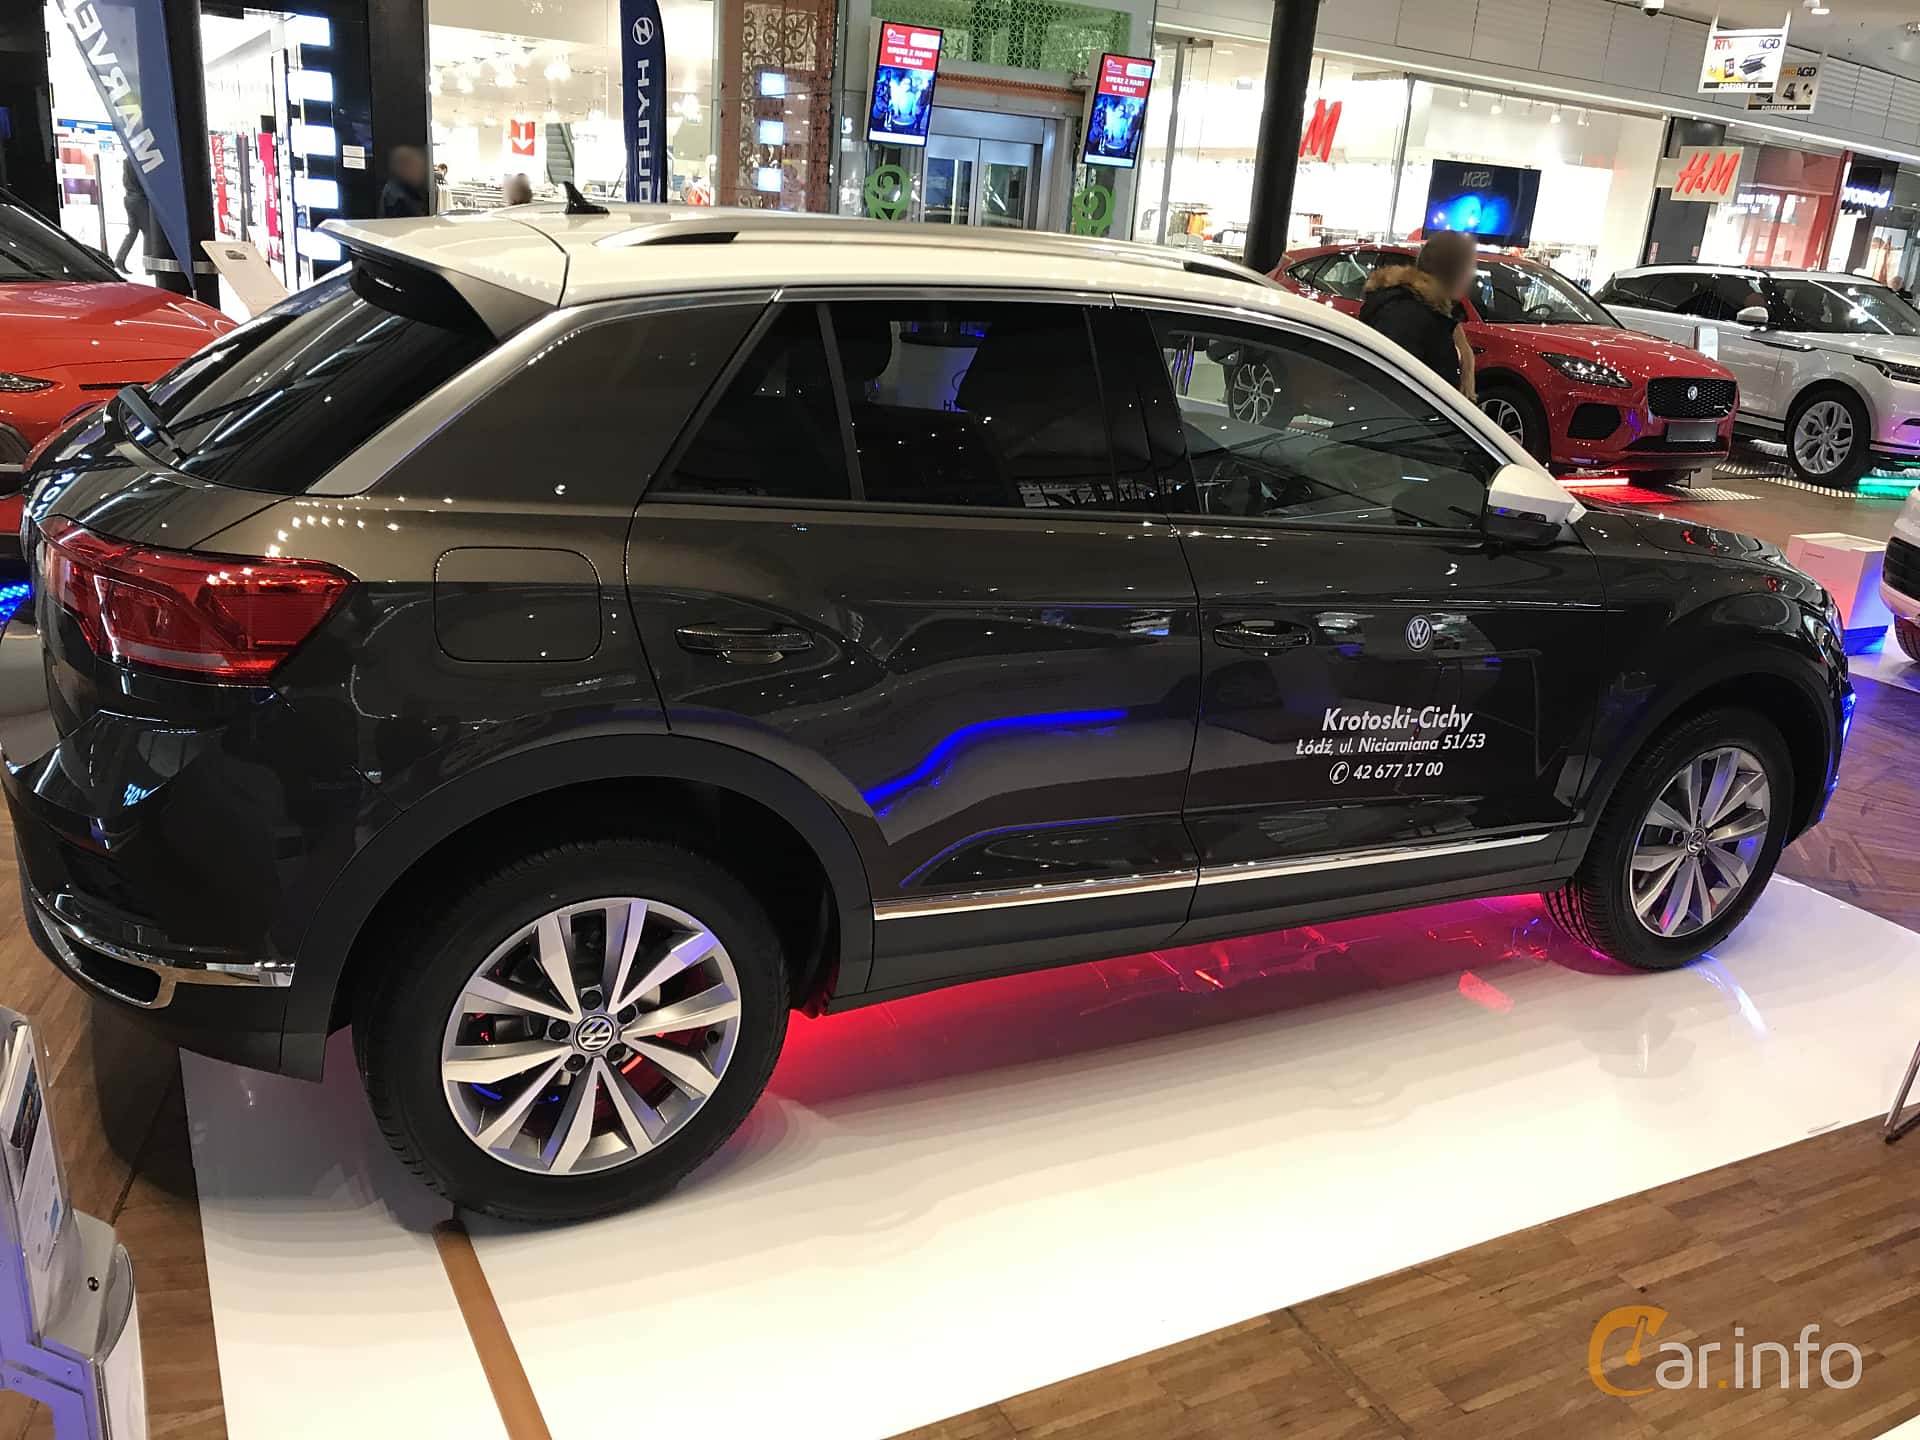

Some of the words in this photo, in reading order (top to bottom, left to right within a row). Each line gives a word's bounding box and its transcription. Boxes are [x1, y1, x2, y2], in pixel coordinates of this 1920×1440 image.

[1759, 38, 1780, 49] AGD
[1797, 67, 1817, 77] AGD
[214, 137, 226, 185] CLARINS
[1675, 151, 1740, 195] H&M
[1842, 187, 1891, 208] romod
[1321, 704, 1473, 732] Krotoski-Cichy
[1295, 737, 1334, 756] Łódź,
[1339, 737, 1354, 753] ul.
[1358, 736, 1439, 753] Niciarniana
[1441, 733, 1486, 750] 51/53
[1353, 764, 1371, 779] 42
[1374, 763, 1402, 779] 677
[1404, 762, 1424, 777] 17
[1425, 761, 1444, 776] 00
